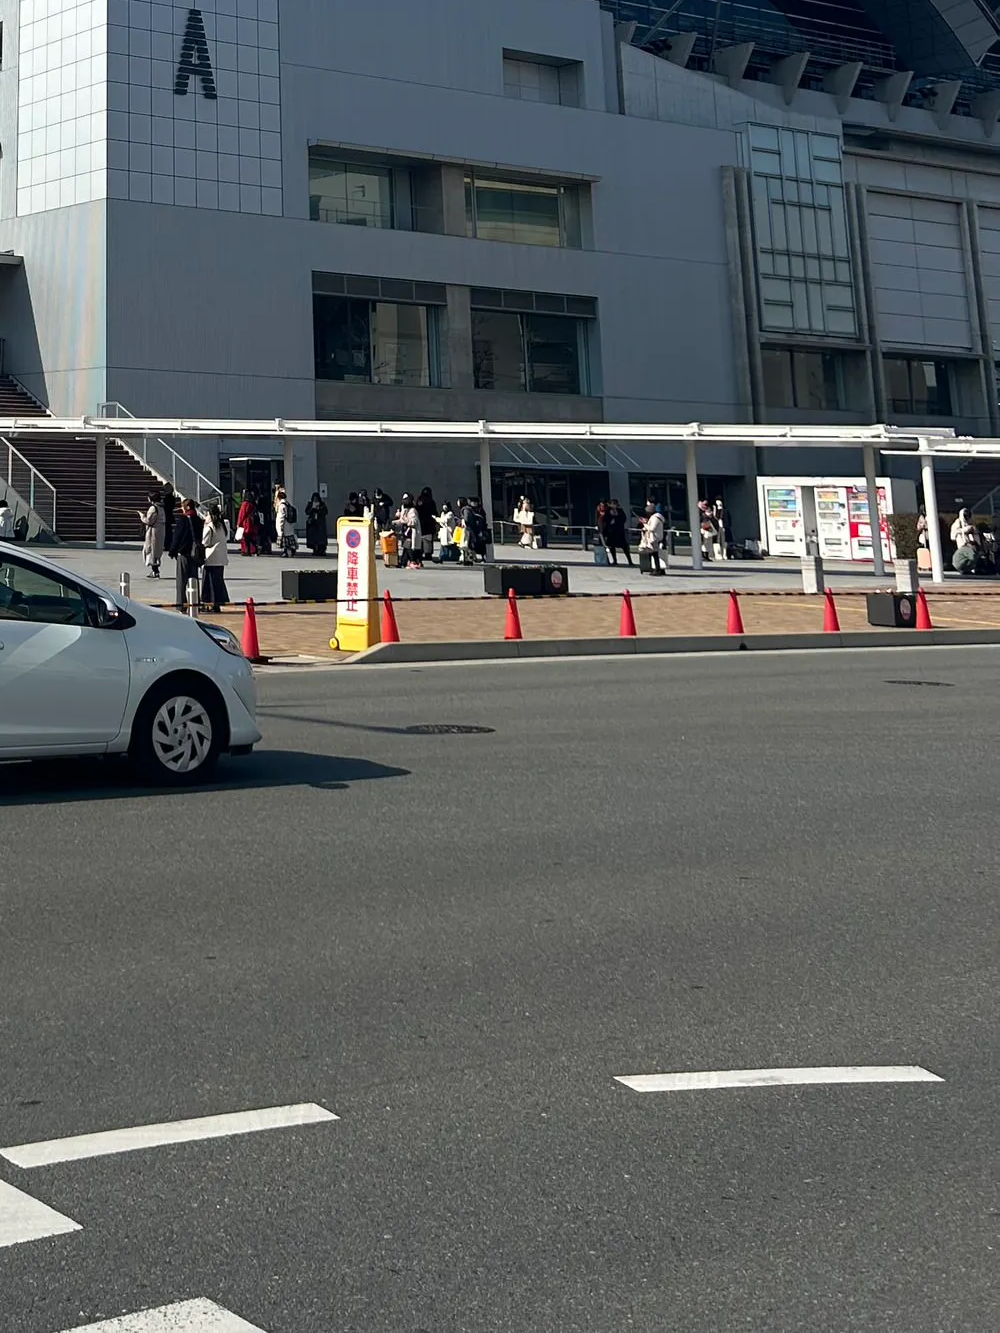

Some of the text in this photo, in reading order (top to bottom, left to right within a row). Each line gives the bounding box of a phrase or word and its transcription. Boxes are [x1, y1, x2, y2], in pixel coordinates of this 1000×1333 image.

[173, 9, 217, 99] A
[346, 551, 358, 612] 降車禁止
